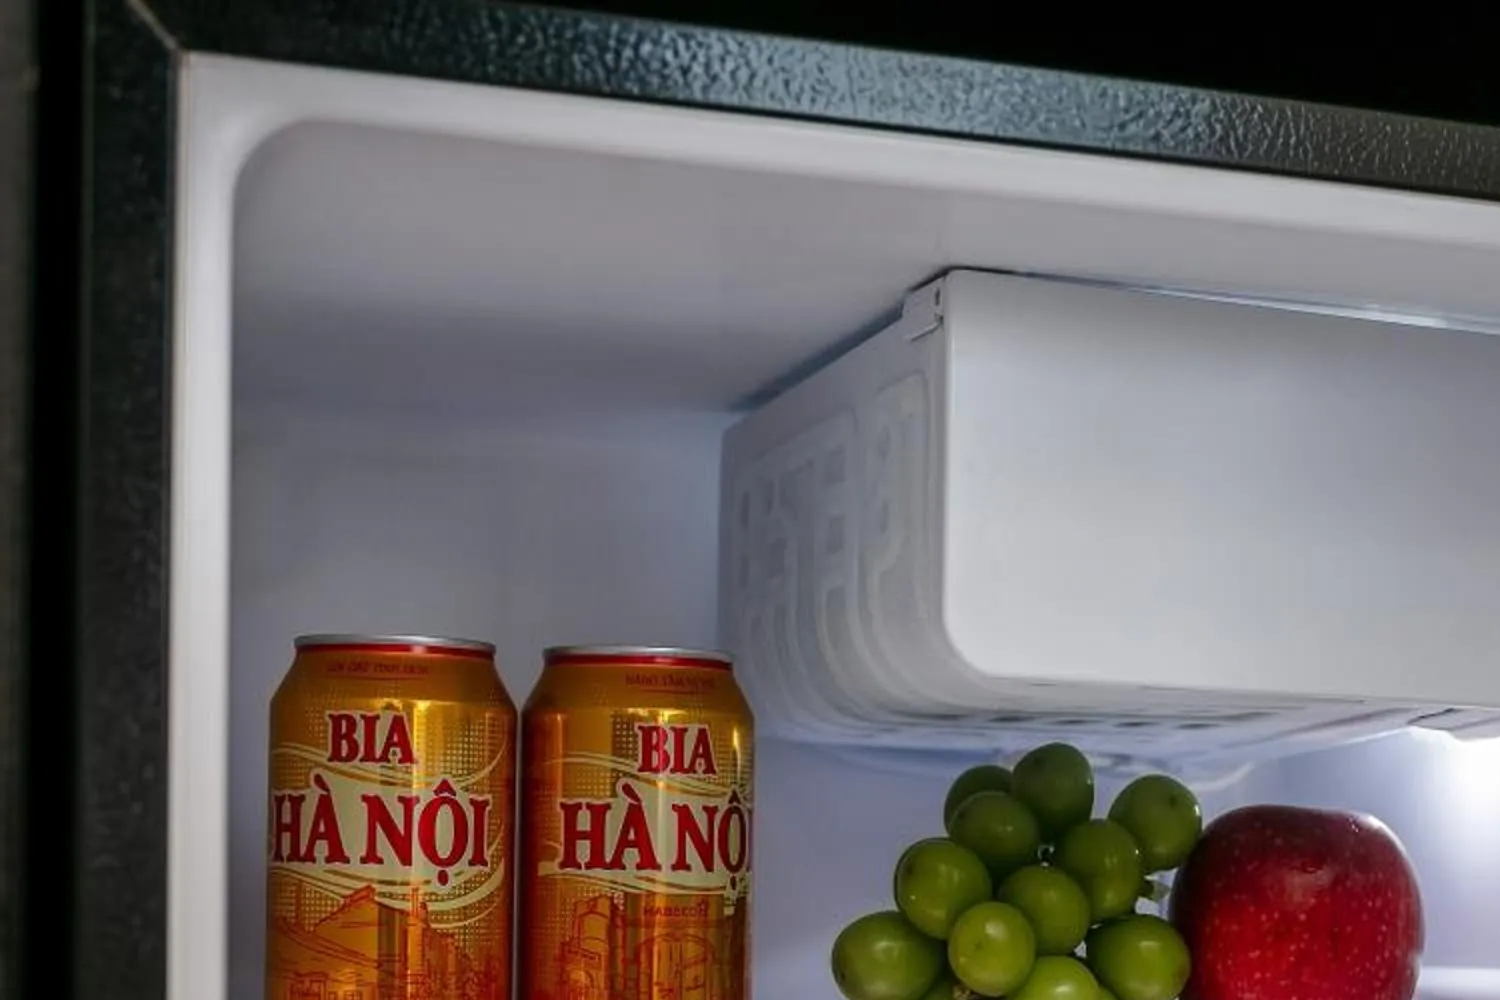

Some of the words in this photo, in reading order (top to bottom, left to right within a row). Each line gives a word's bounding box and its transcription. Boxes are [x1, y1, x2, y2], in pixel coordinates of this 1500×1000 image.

[327, 712, 418, 765] BIA
[635, 724, 716, 776] BIA
[273, 772, 350, 866] HÀ
[361, 780, 492, 887] NỘI
[558, 782, 660, 872] HÀ
